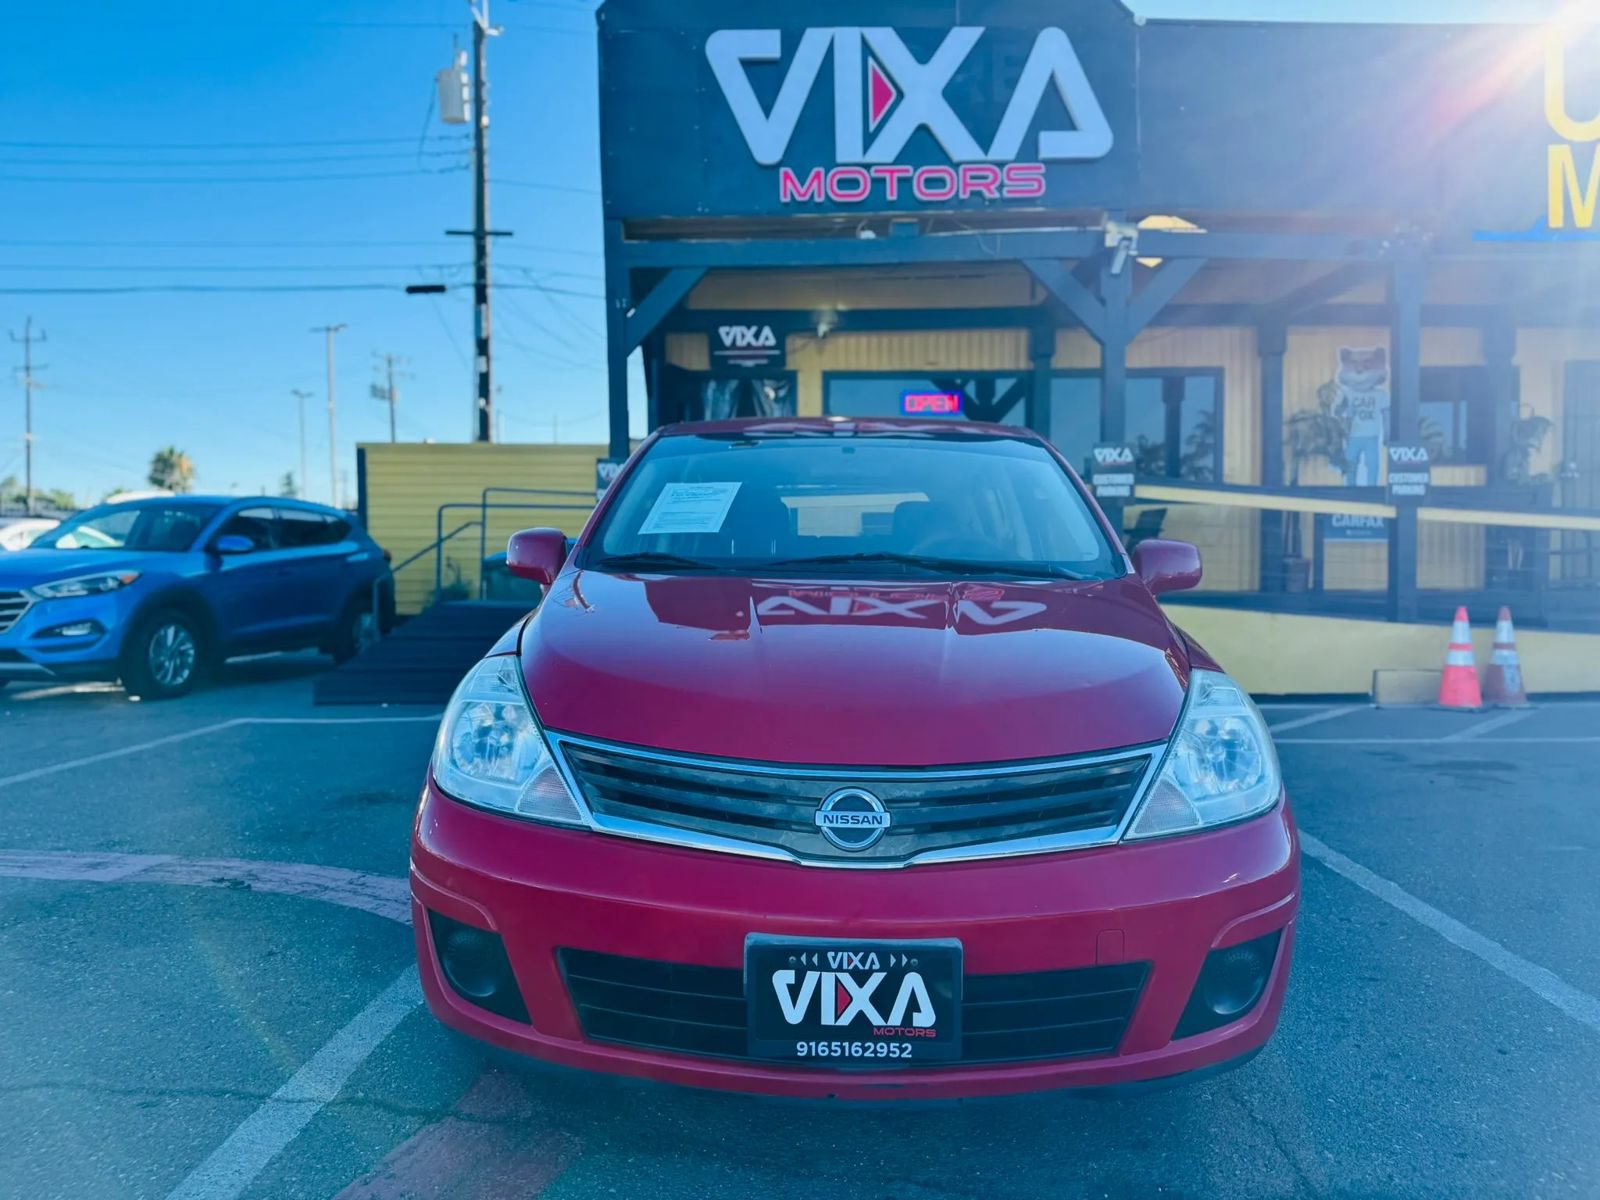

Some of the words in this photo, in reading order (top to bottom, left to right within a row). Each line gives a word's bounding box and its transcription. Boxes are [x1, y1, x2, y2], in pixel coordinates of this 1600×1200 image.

[705, 26, 1113, 165] VIXA
[779, 163, 1046, 203] MOTORS
[718, 325, 777, 347] VIXA
[904, 394, 959, 413] OPEN
[1093, 447, 1134, 464] VIXA
[1389, 447, 1429, 462] VIXA
[823, 814, 883, 825] NISSAN
[827, 951, 880, 970] VIXA
[772, 969, 936, 1028] VIXA
[873, 1027, 937, 1038] MOTORS
[796, 1041, 912, 1058] 9165162952
